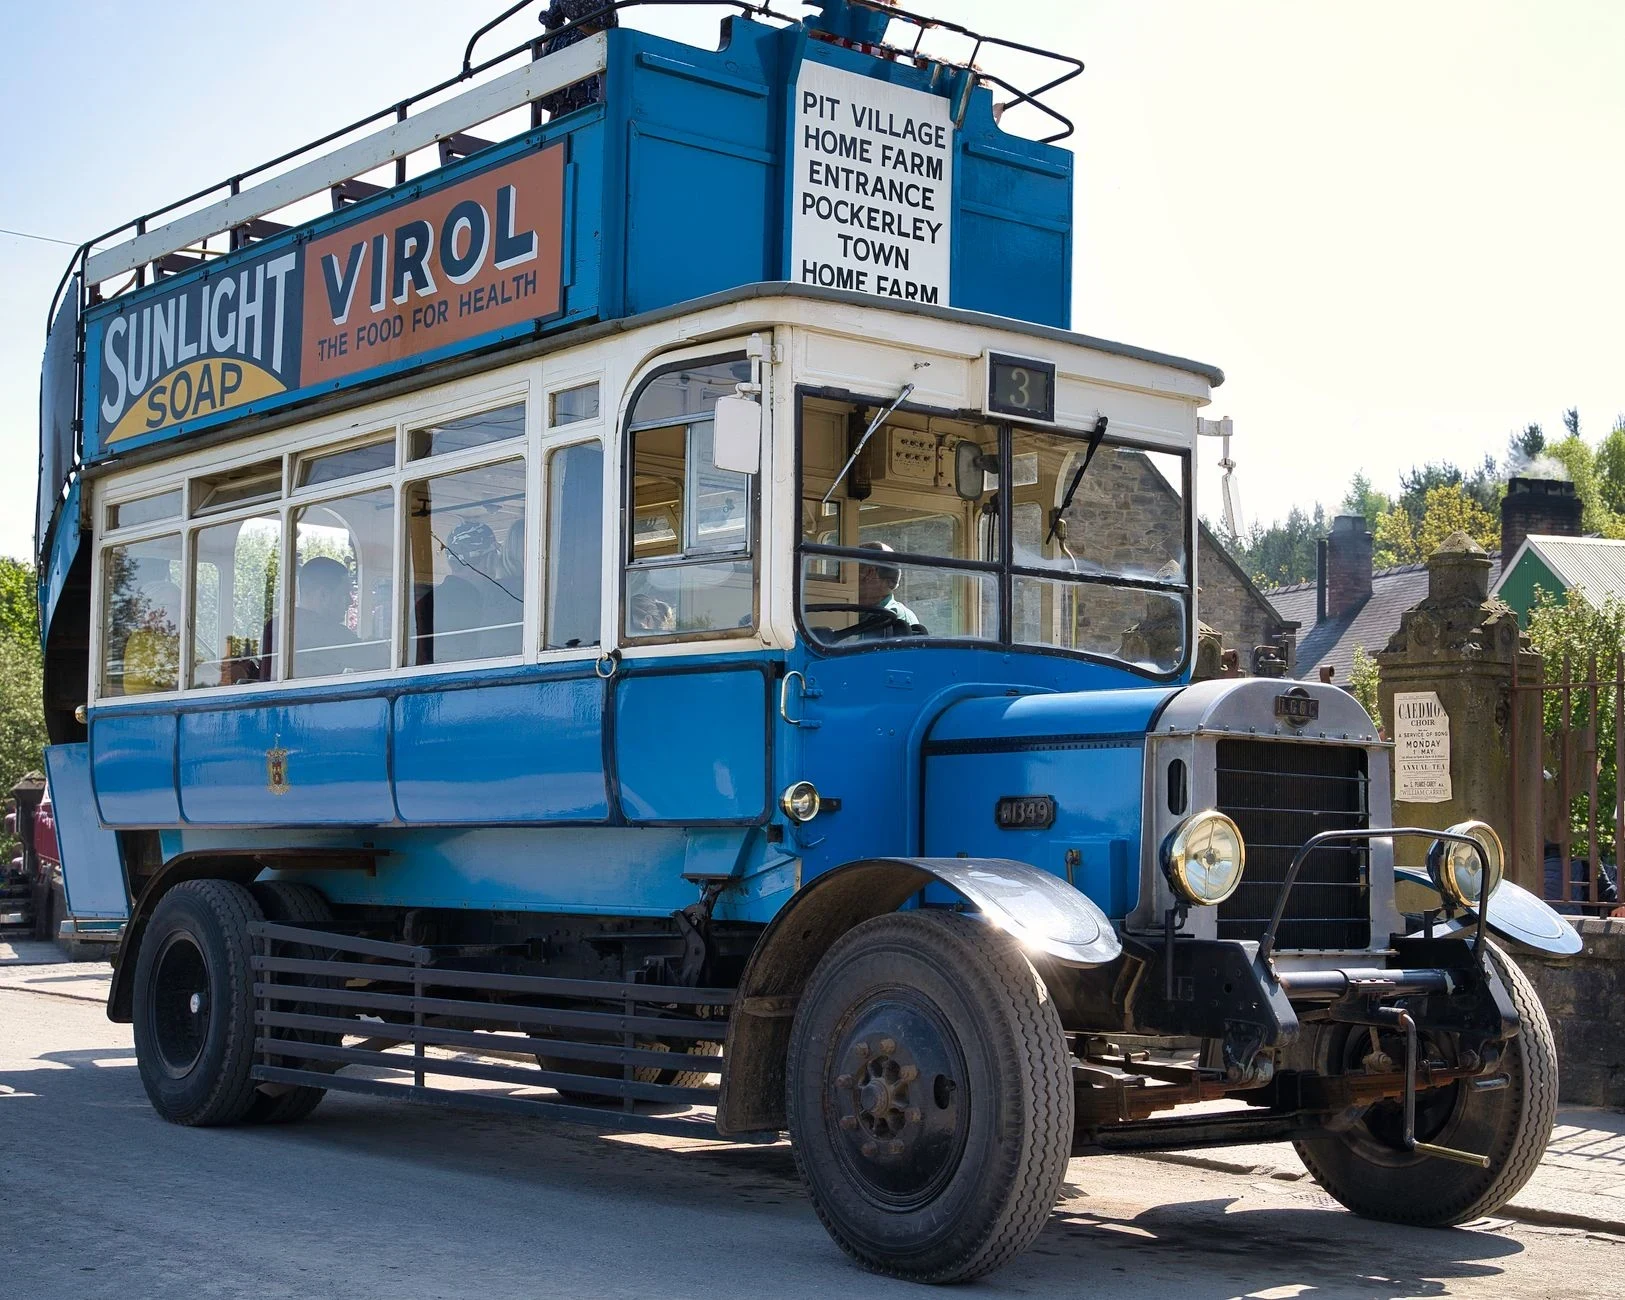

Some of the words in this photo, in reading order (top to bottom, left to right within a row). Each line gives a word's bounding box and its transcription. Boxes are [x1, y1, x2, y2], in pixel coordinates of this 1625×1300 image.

[803, 91, 840, 121] PIT
[851, 103, 946, 149] VILLAGE
[804, 125, 872, 164] HOME
[882, 144, 943, 181] FARM
[809, 160, 935, 211] ENTRANCE
[802, 192, 943, 244] POCKERLEY
[320, 184, 539, 326] VIROL
[837, 233, 909, 271] TOWN
[802, 259, 869, 292] HOME
[876, 275, 938, 305] FARM
[101, 252, 297, 424] SUNLIGHT
[318, 331, 348, 362] THE
[356, 314, 405, 351] FOOD
[412, 302, 449, 335] FOR
[459, 270, 537, 318] HEALTH
[145, 362, 243, 429] SOAP
[1009, 368, 1030, 408] 3
[1398, 702, 1446, 719] CAEDMO
[1411, 719, 1435, 727] CHOIR
[1406, 740, 1441, 748] MONDAY
